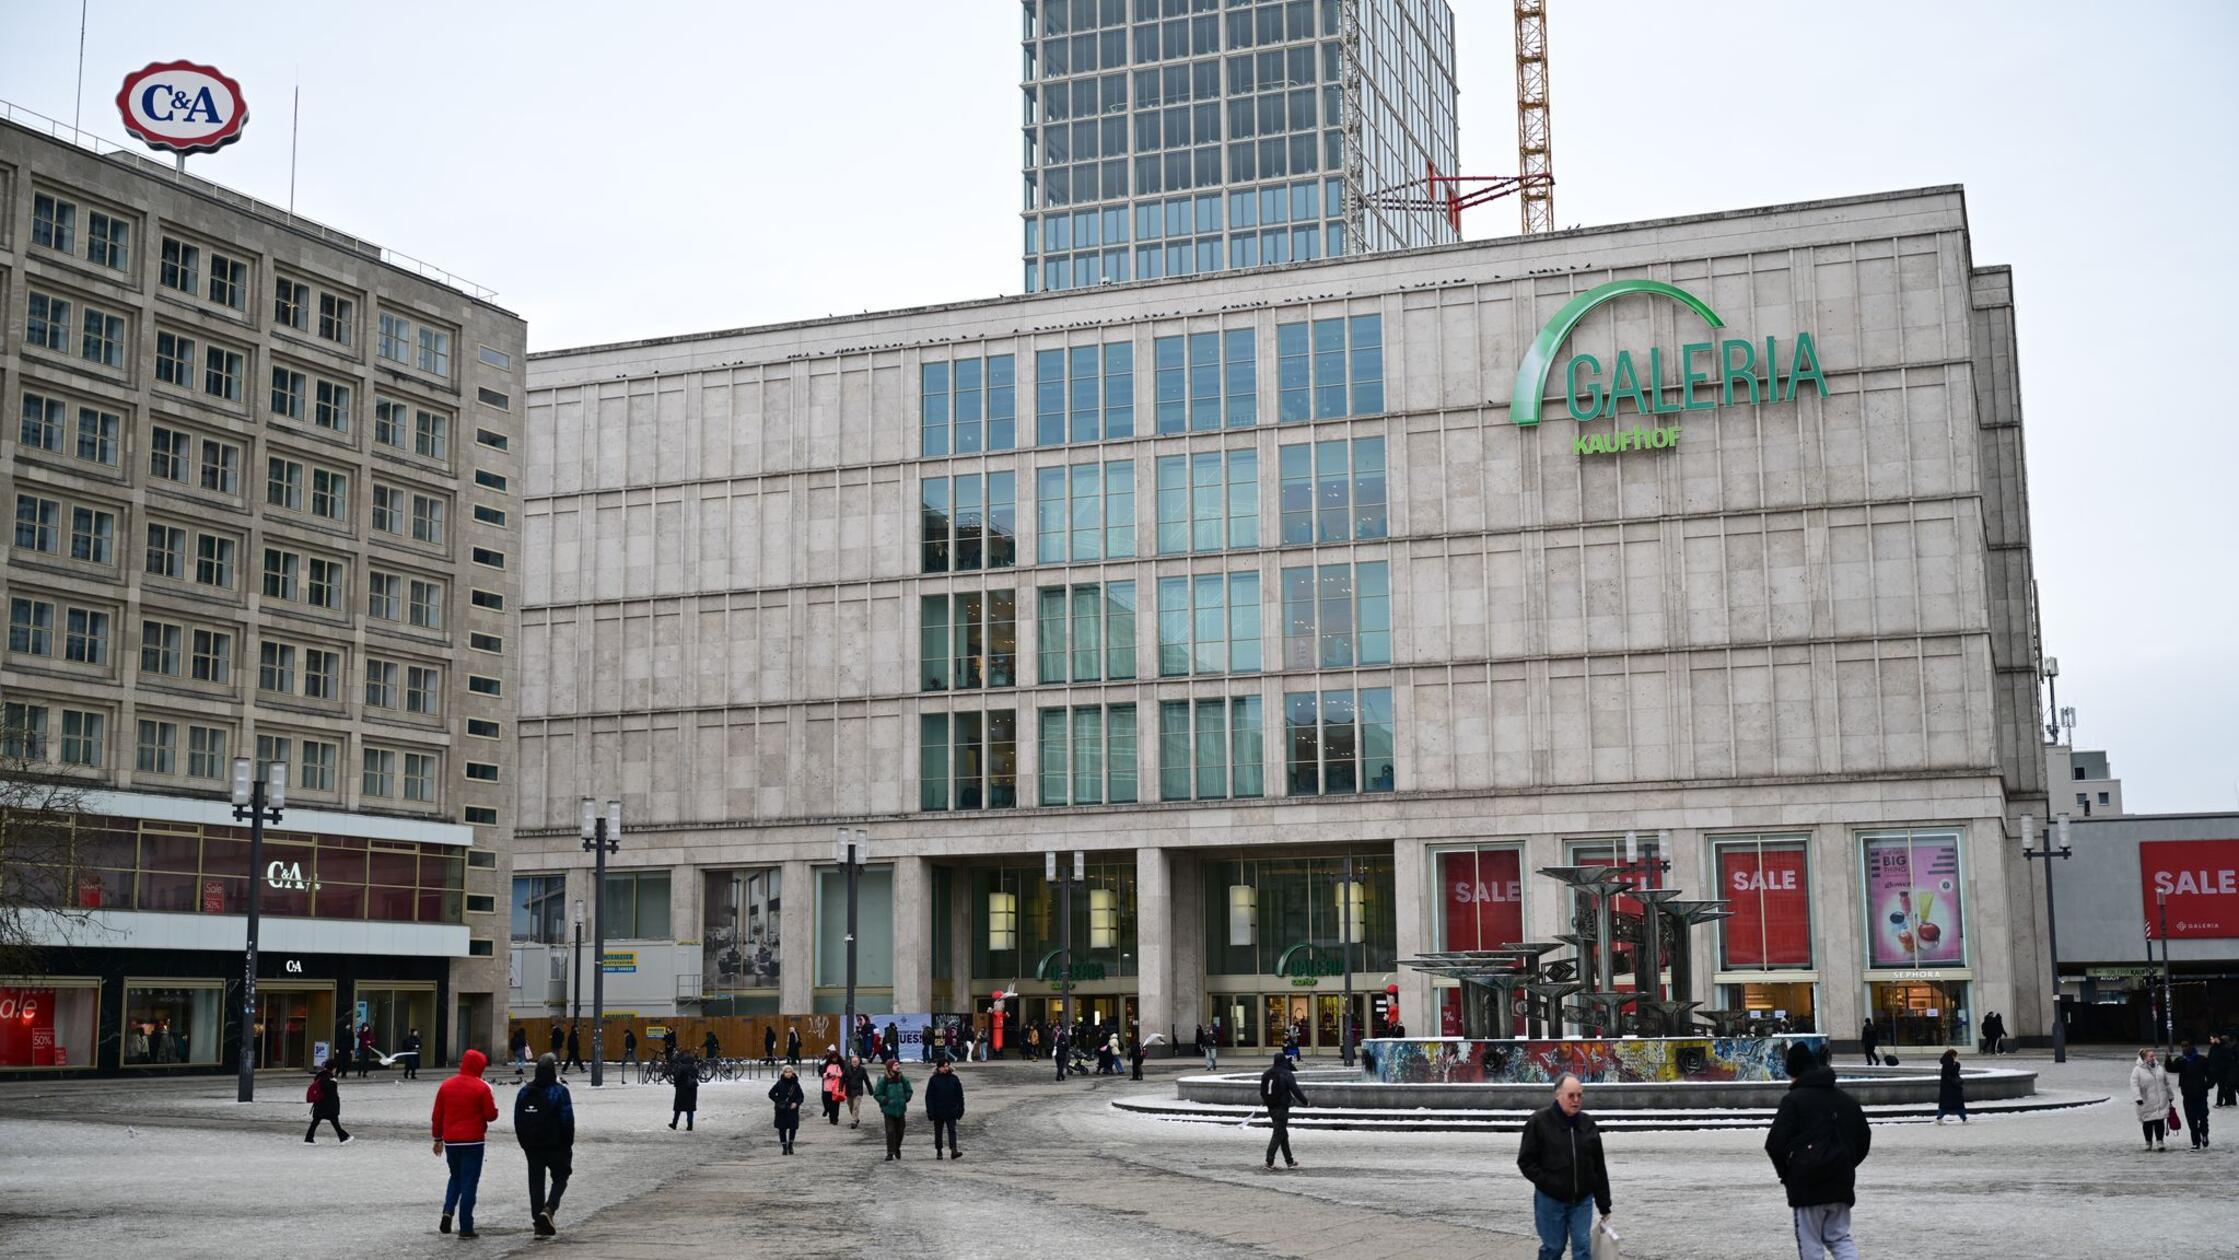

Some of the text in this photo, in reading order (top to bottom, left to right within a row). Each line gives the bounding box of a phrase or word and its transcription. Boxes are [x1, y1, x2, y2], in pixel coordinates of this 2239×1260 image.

[142, 84, 223, 124] C&A
[1565, 331, 1830, 422] GALERIA
[1883, 856, 1906, 866] BIG
[267, 860, 305, 889] C&A
[1734, 870, 1796, 890] SALE
[2154, 870, 2237, 895] SALE
[1455, 881, 1520, 903] SALE
[1893, 970, 1941, 979] SEPHORA
[34, 1036, 52, 1045] 50%
[899, 1034, 922, 1044] UES!
